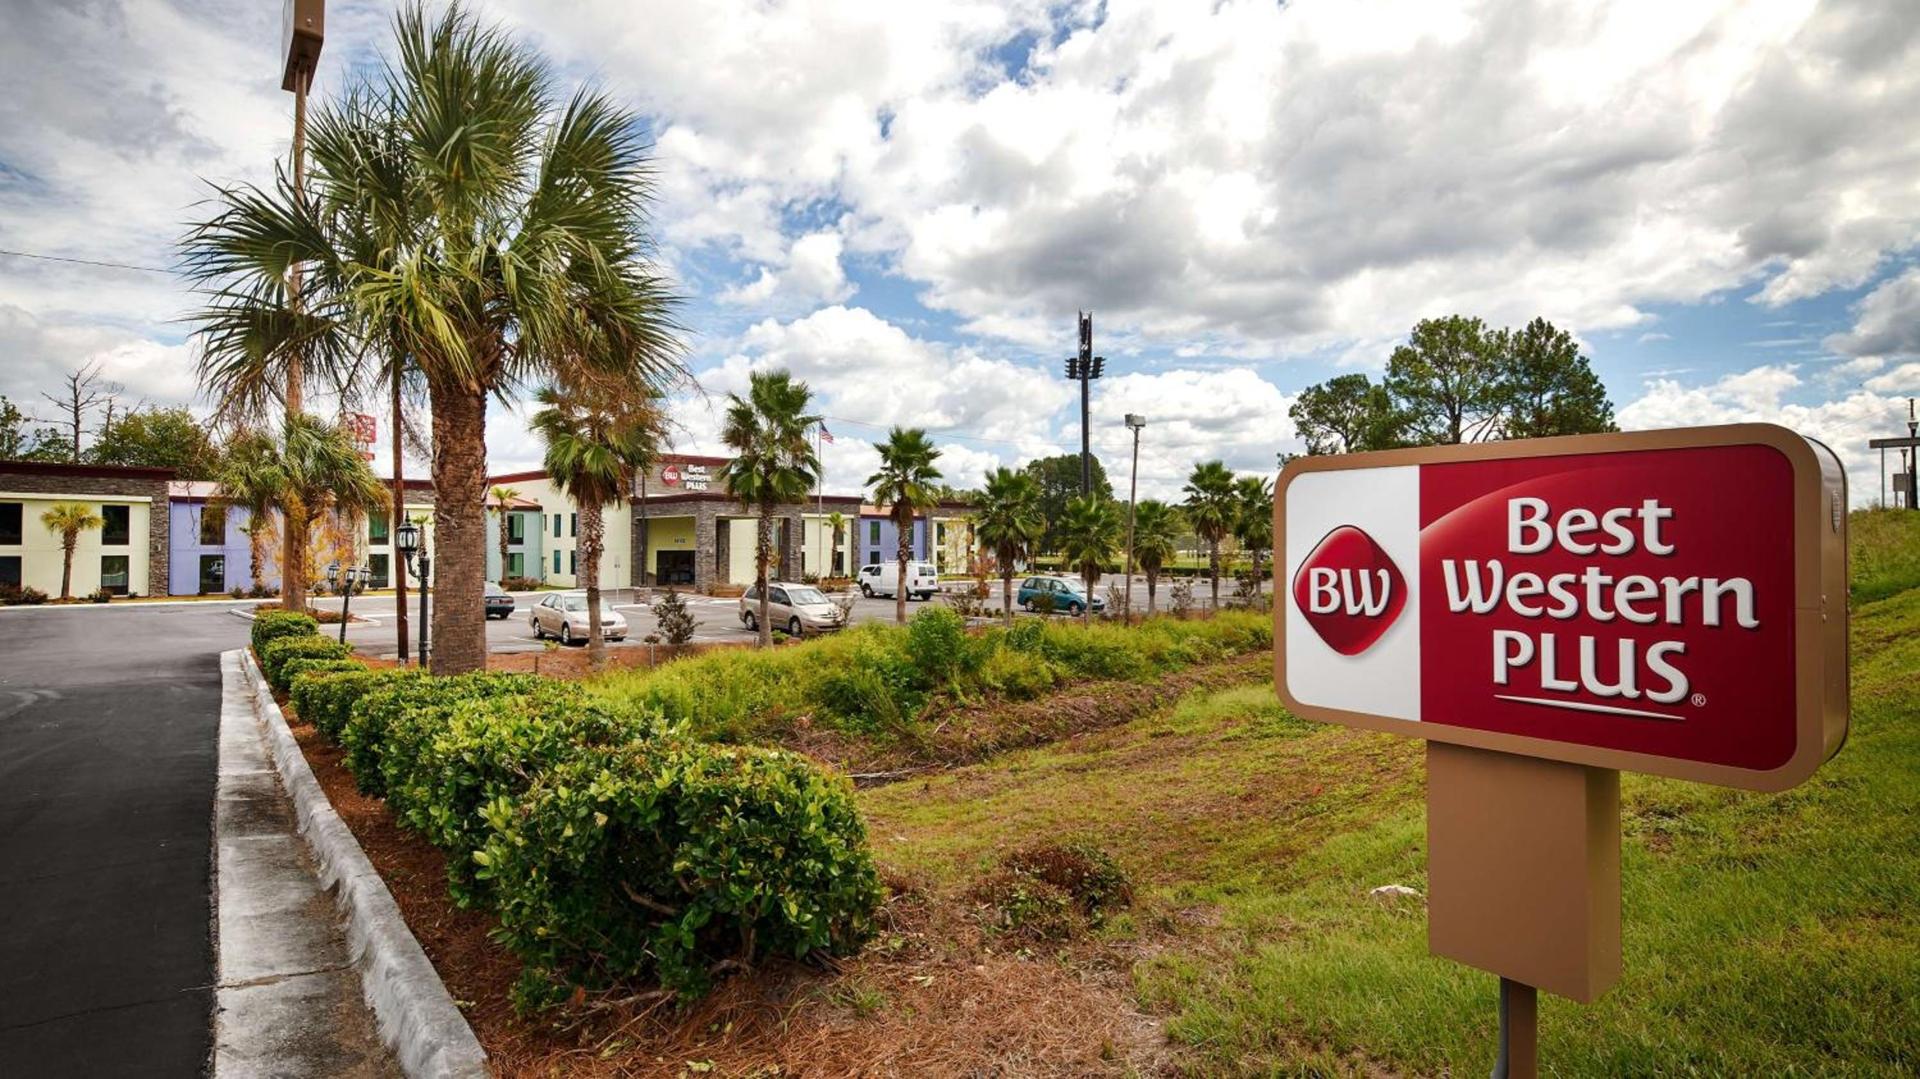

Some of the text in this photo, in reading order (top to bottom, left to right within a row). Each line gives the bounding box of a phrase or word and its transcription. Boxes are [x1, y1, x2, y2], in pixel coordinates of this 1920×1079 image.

[686, 481, 707, 490] PLUS
[688, 464, 705, 473] Best
[1508, 497, 1674, 555] Best
[1309, 567, 1391, 617] BW
[1442, 559, 1760, 628] Western
[1493, 629, 1690, 704] PLUS
